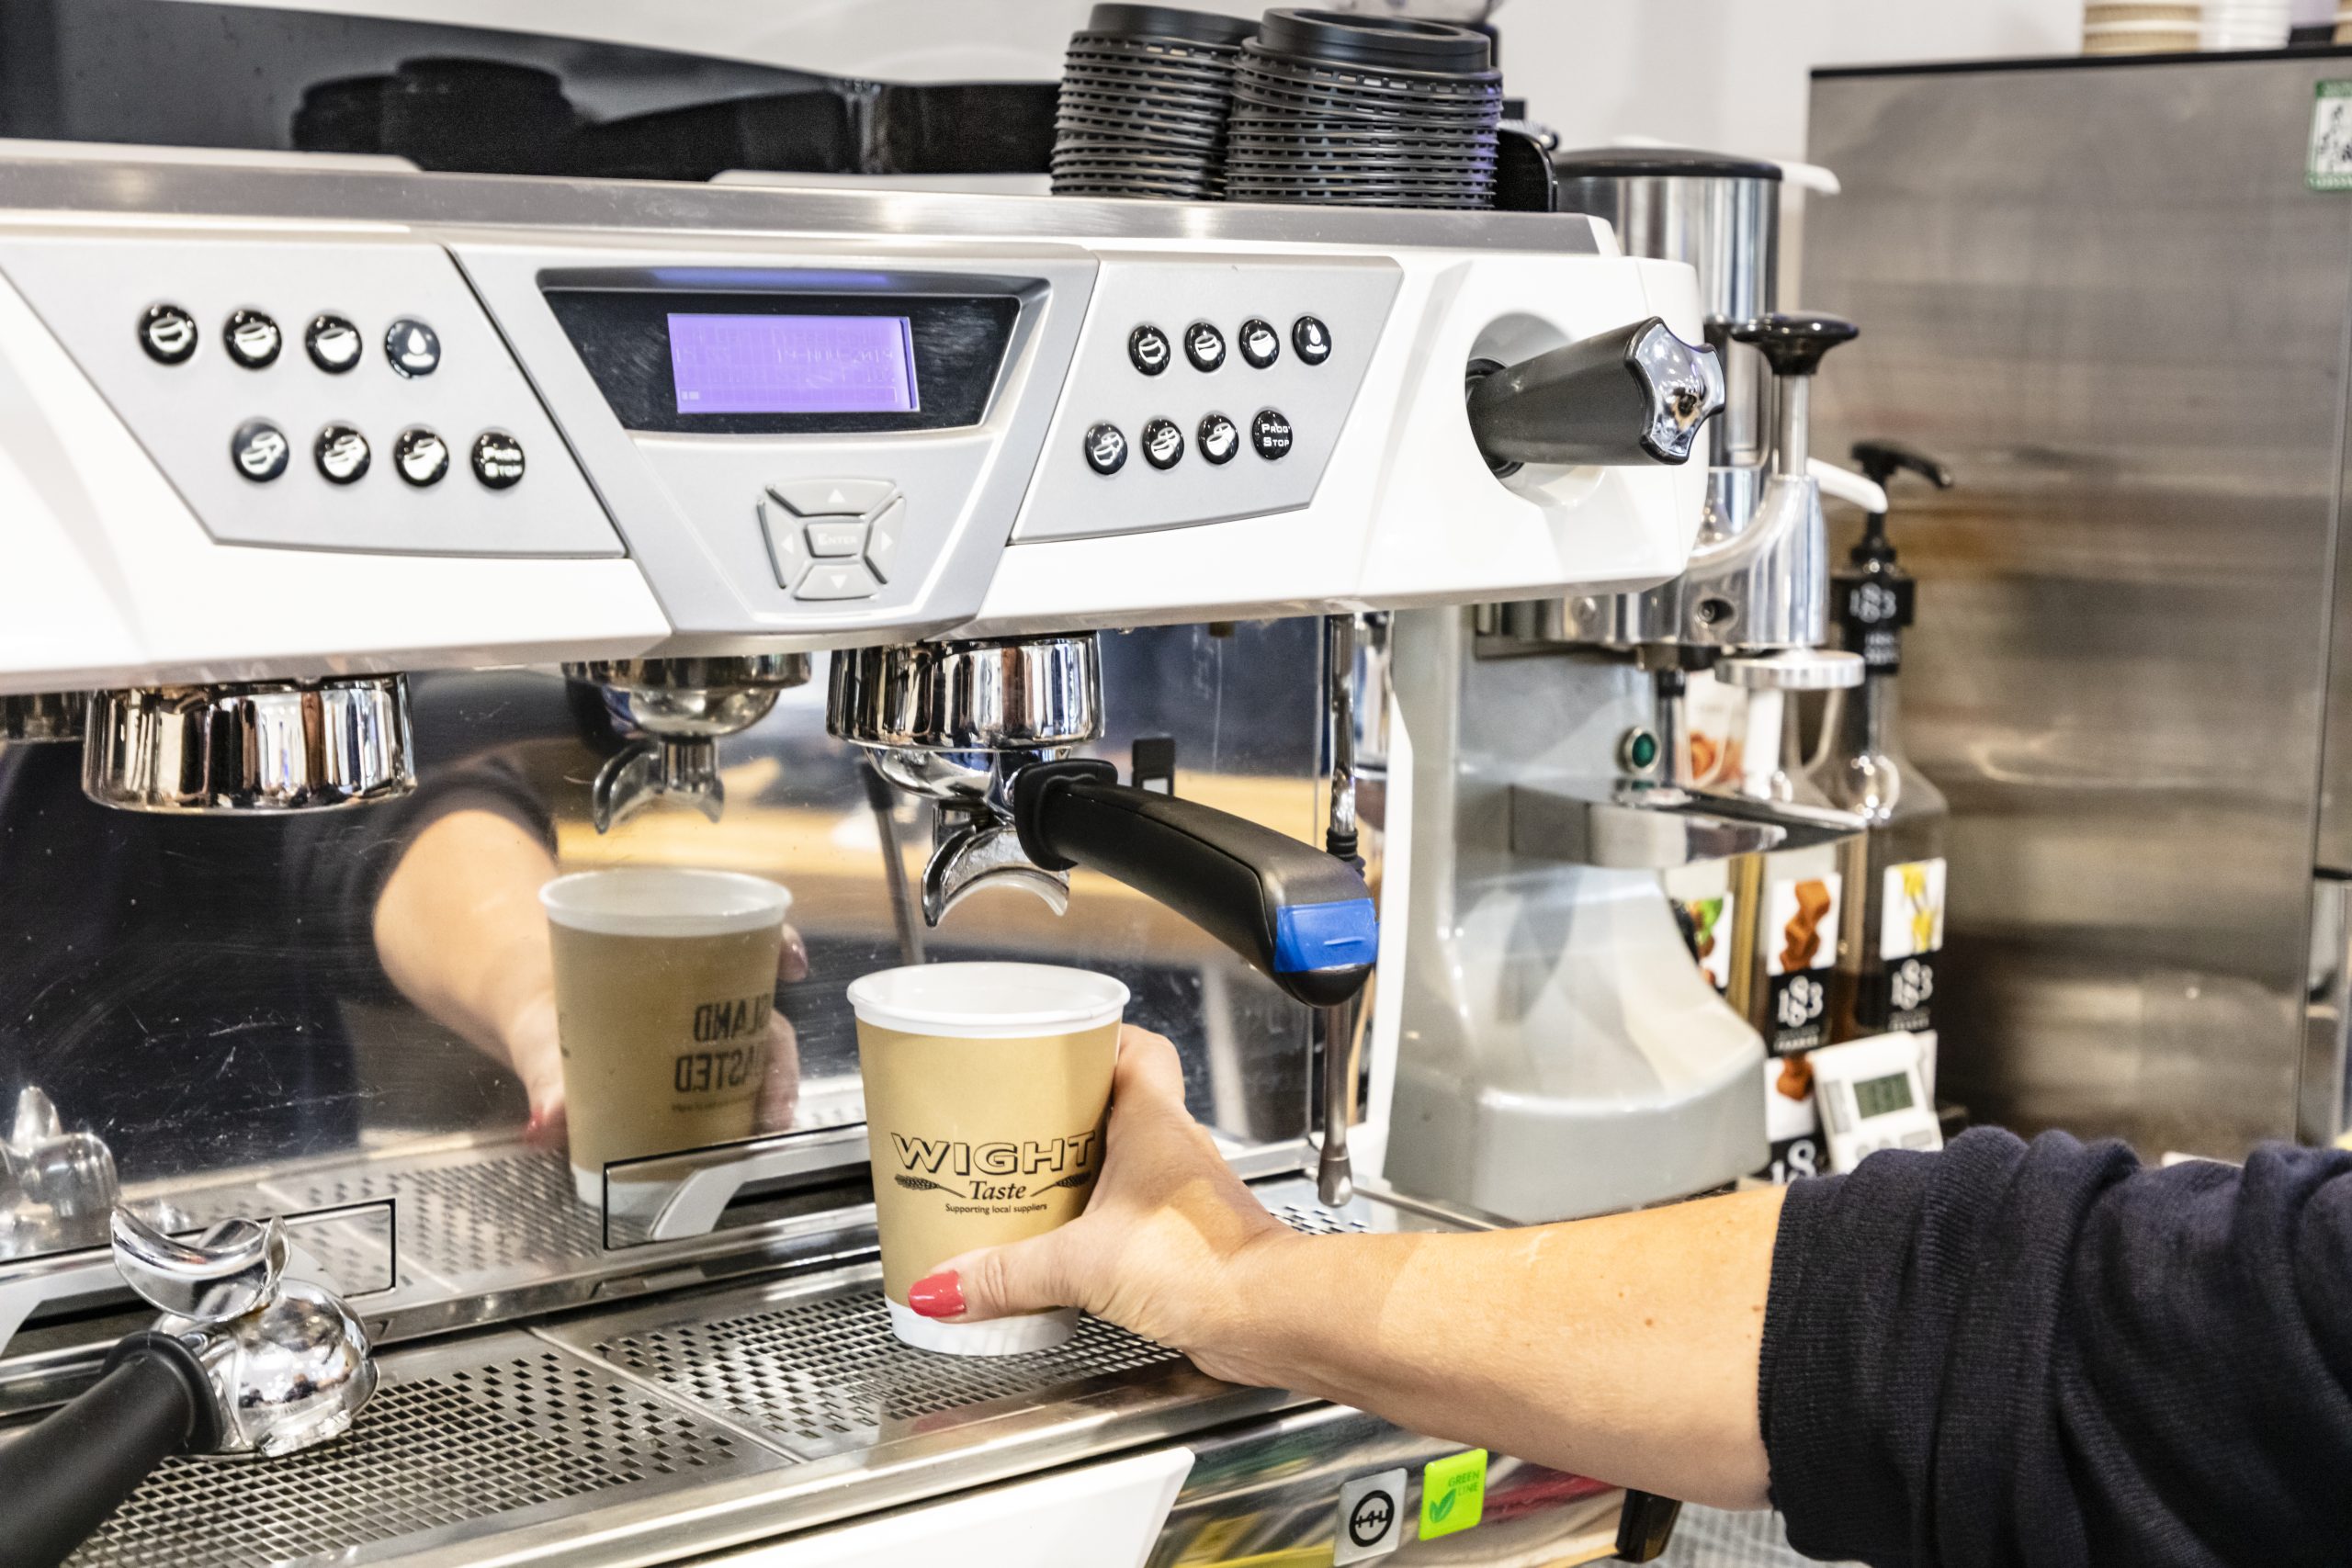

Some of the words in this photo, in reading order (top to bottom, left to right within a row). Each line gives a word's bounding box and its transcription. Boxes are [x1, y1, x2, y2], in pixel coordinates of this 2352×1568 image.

[890, 1131, 1095, 1176] WIGHT
[969, 1180, 1026, 1200] Taste
[945, 1203, 989, 1214] Supporting
[1013, 1203, 1046, 1213] suppliers
[1448, 1470, 1480, 1487] GREEN
[1457, 1482, 1477, 1496] LINE
